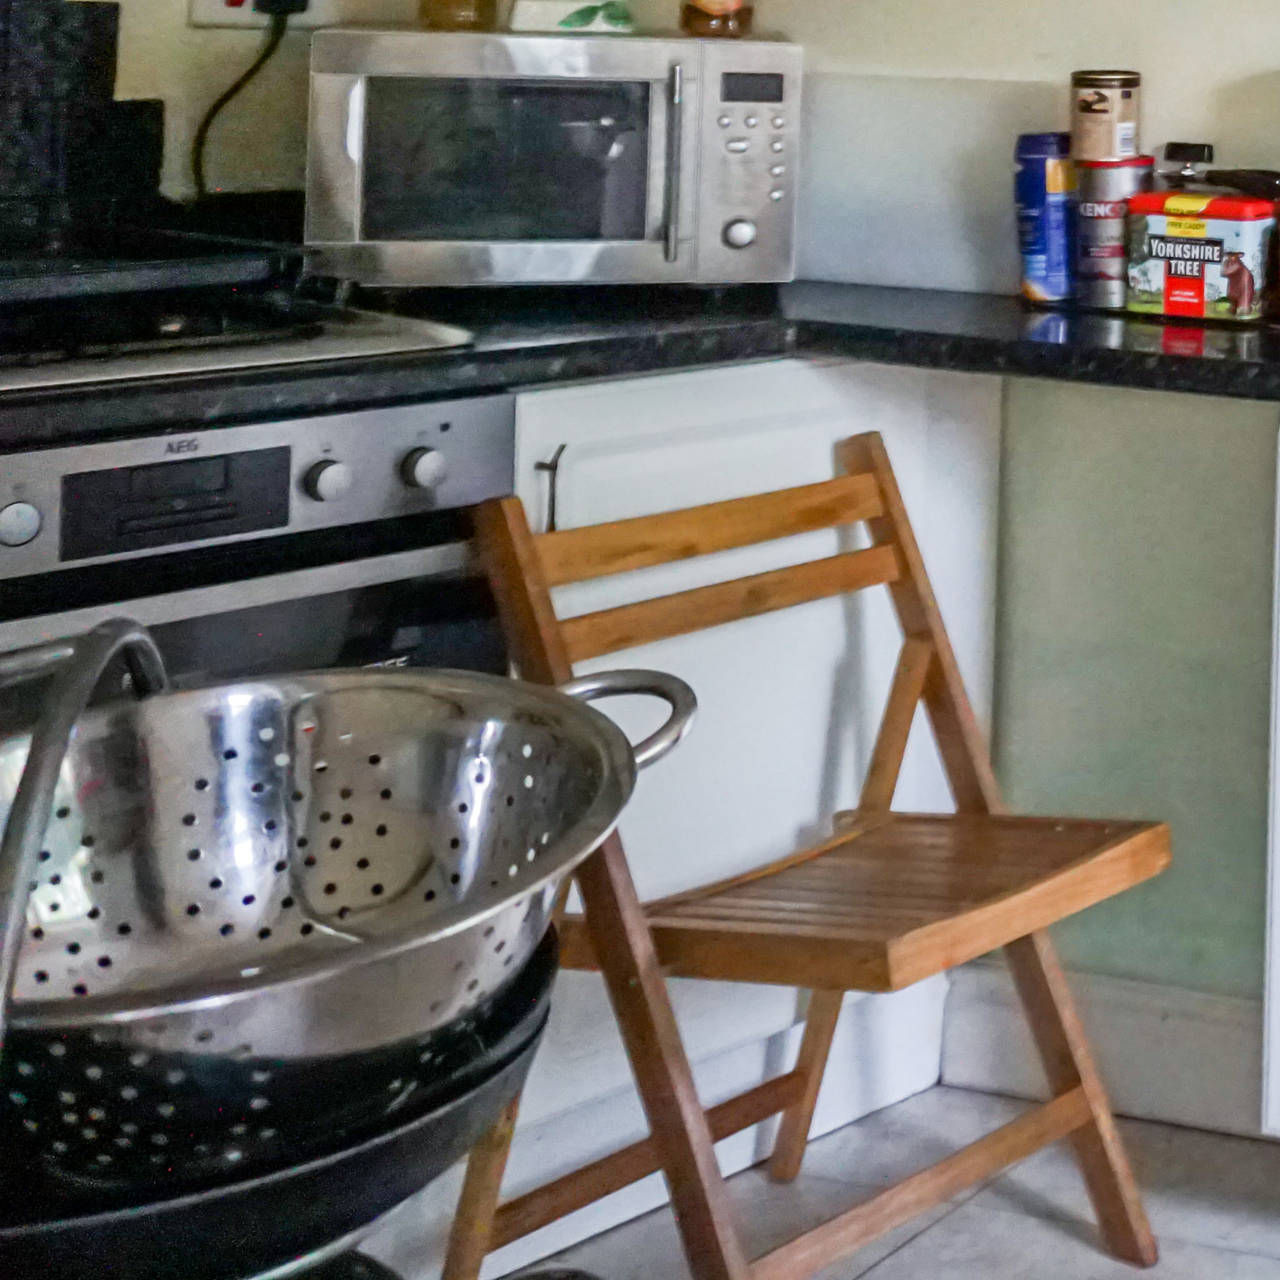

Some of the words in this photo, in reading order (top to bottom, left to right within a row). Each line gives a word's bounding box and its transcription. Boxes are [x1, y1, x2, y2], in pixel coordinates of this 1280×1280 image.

[1150, 239, 1220, 261] YORKSHIRE
[1170, 260, 1200, 276] TREE
[164, 438, 199, 455] AEG
